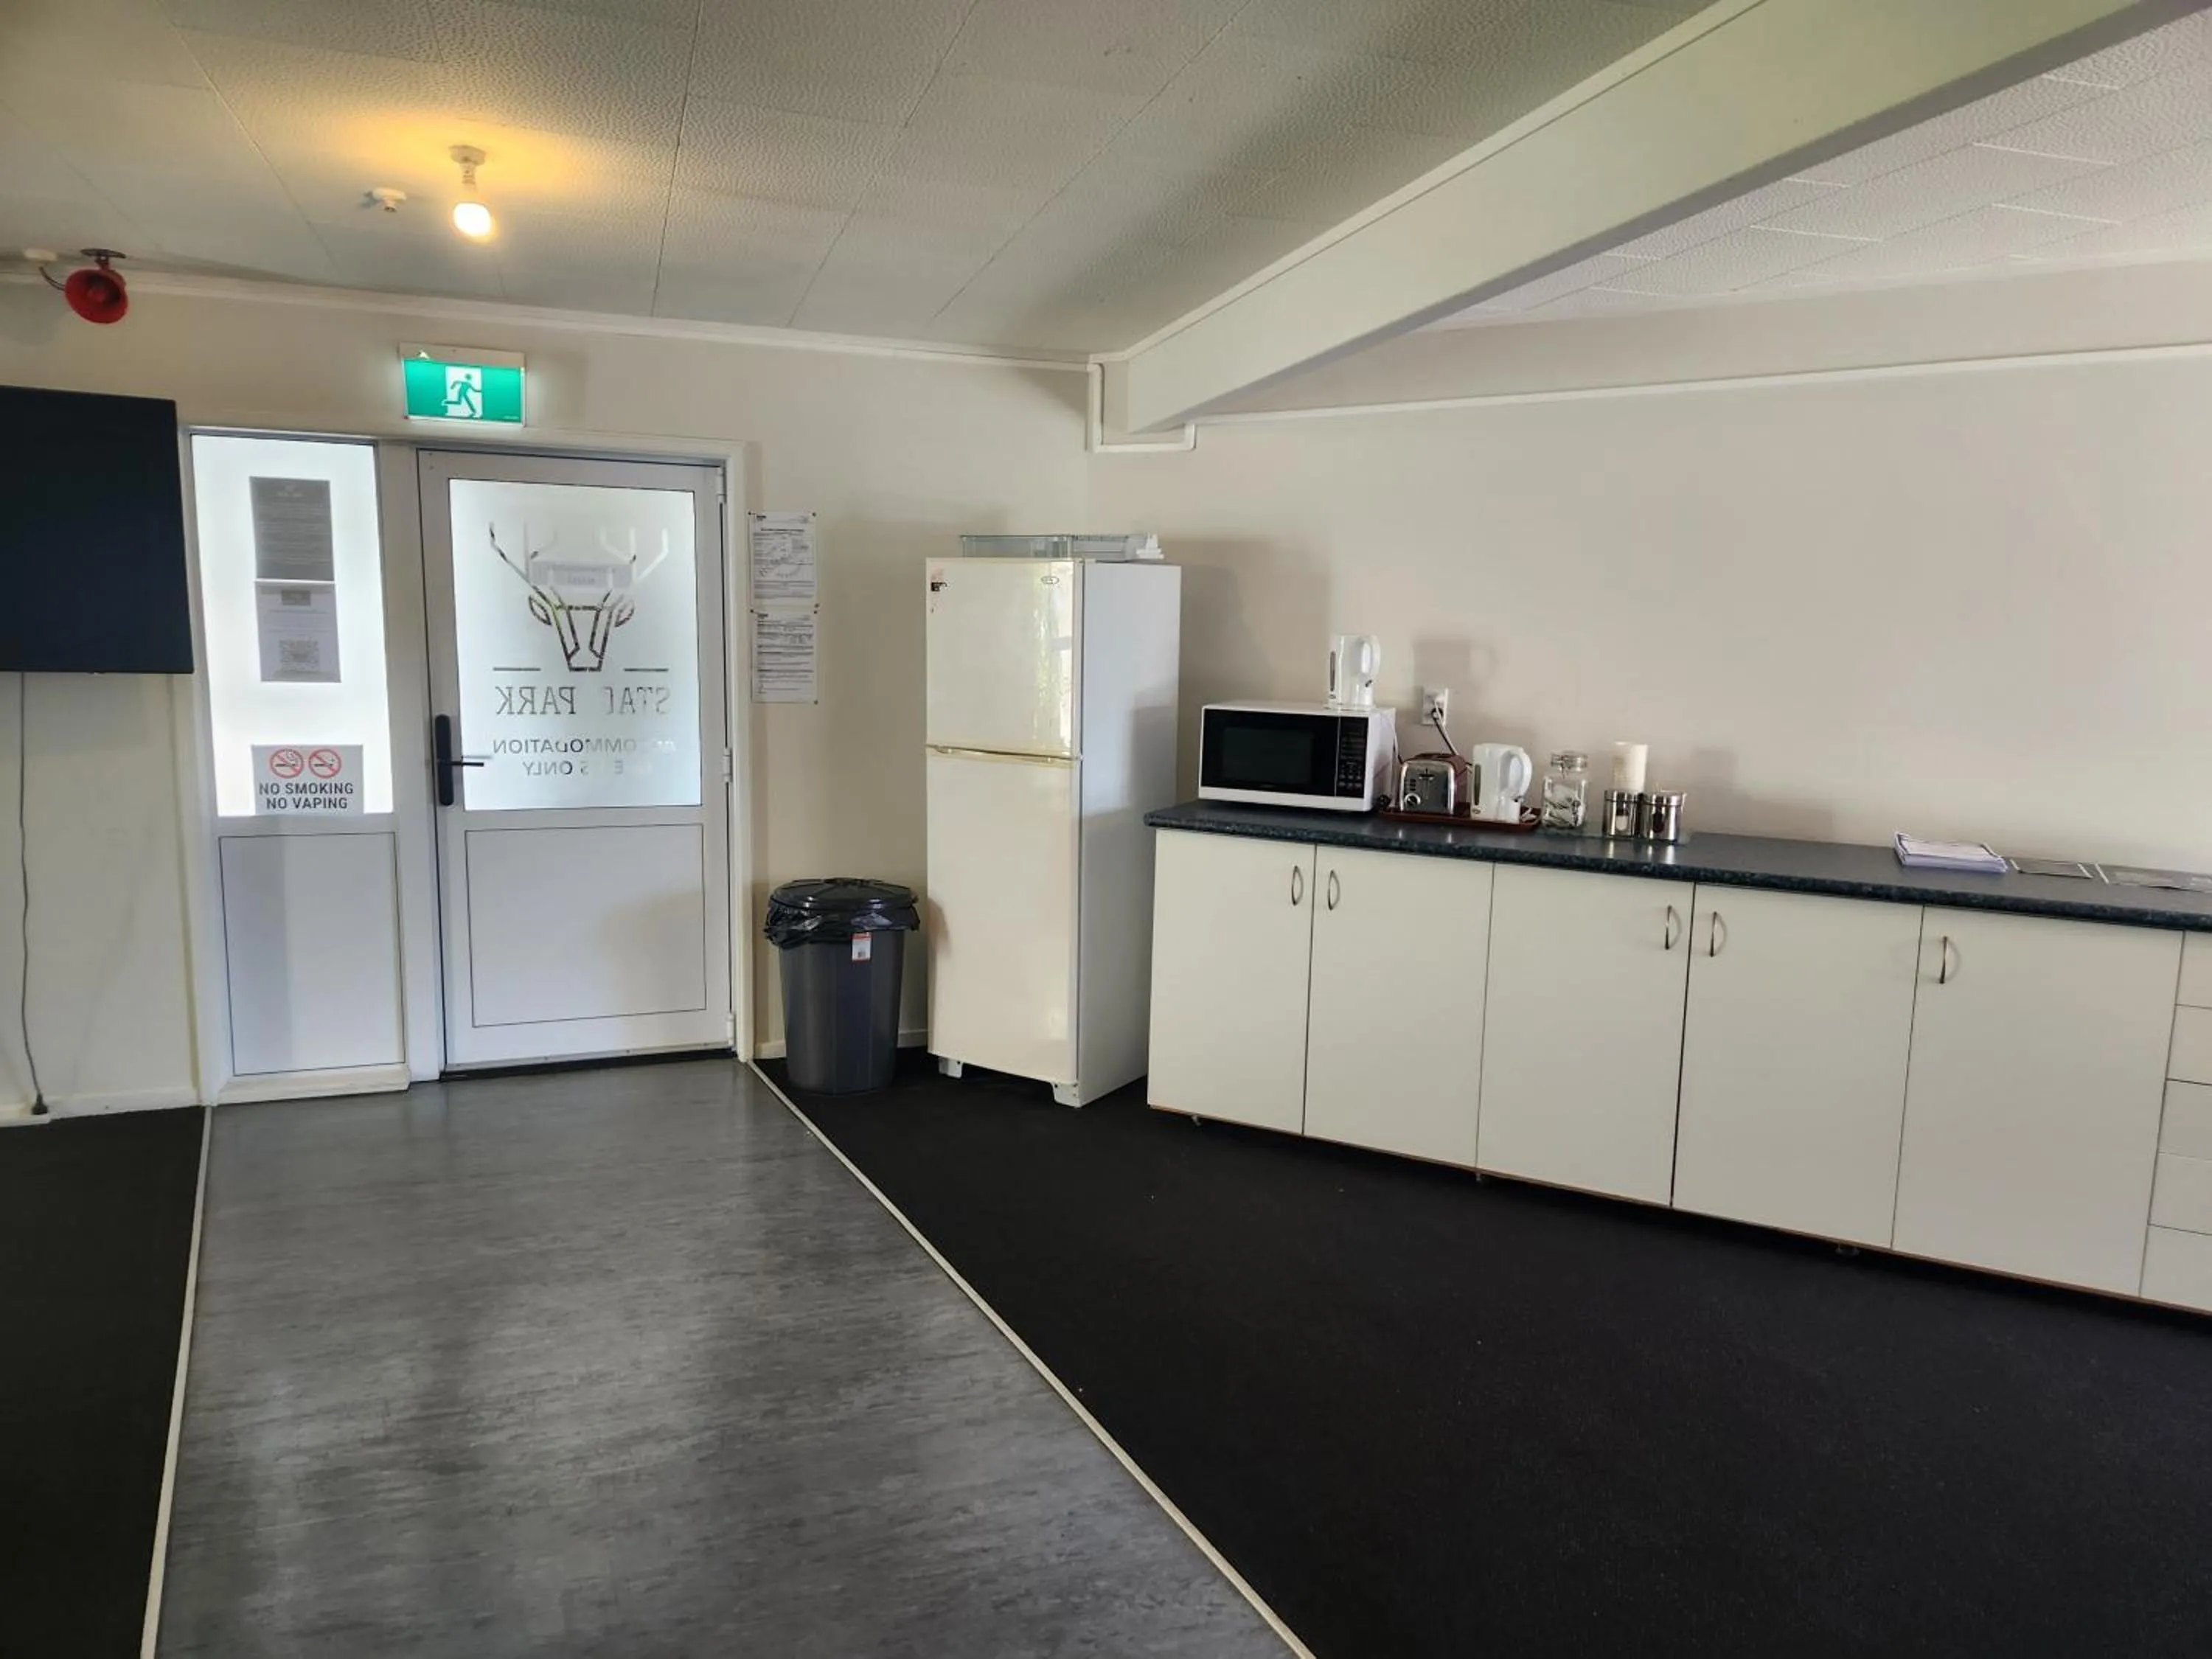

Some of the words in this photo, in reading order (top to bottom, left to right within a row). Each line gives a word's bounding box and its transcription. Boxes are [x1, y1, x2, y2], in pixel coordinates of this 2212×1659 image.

[259, 782, 279, 794] NO
[285, 782, 354, 794] SMOKING
[266, 797, 287, 809] NO
[293, 797, 348, 809] VAPING
